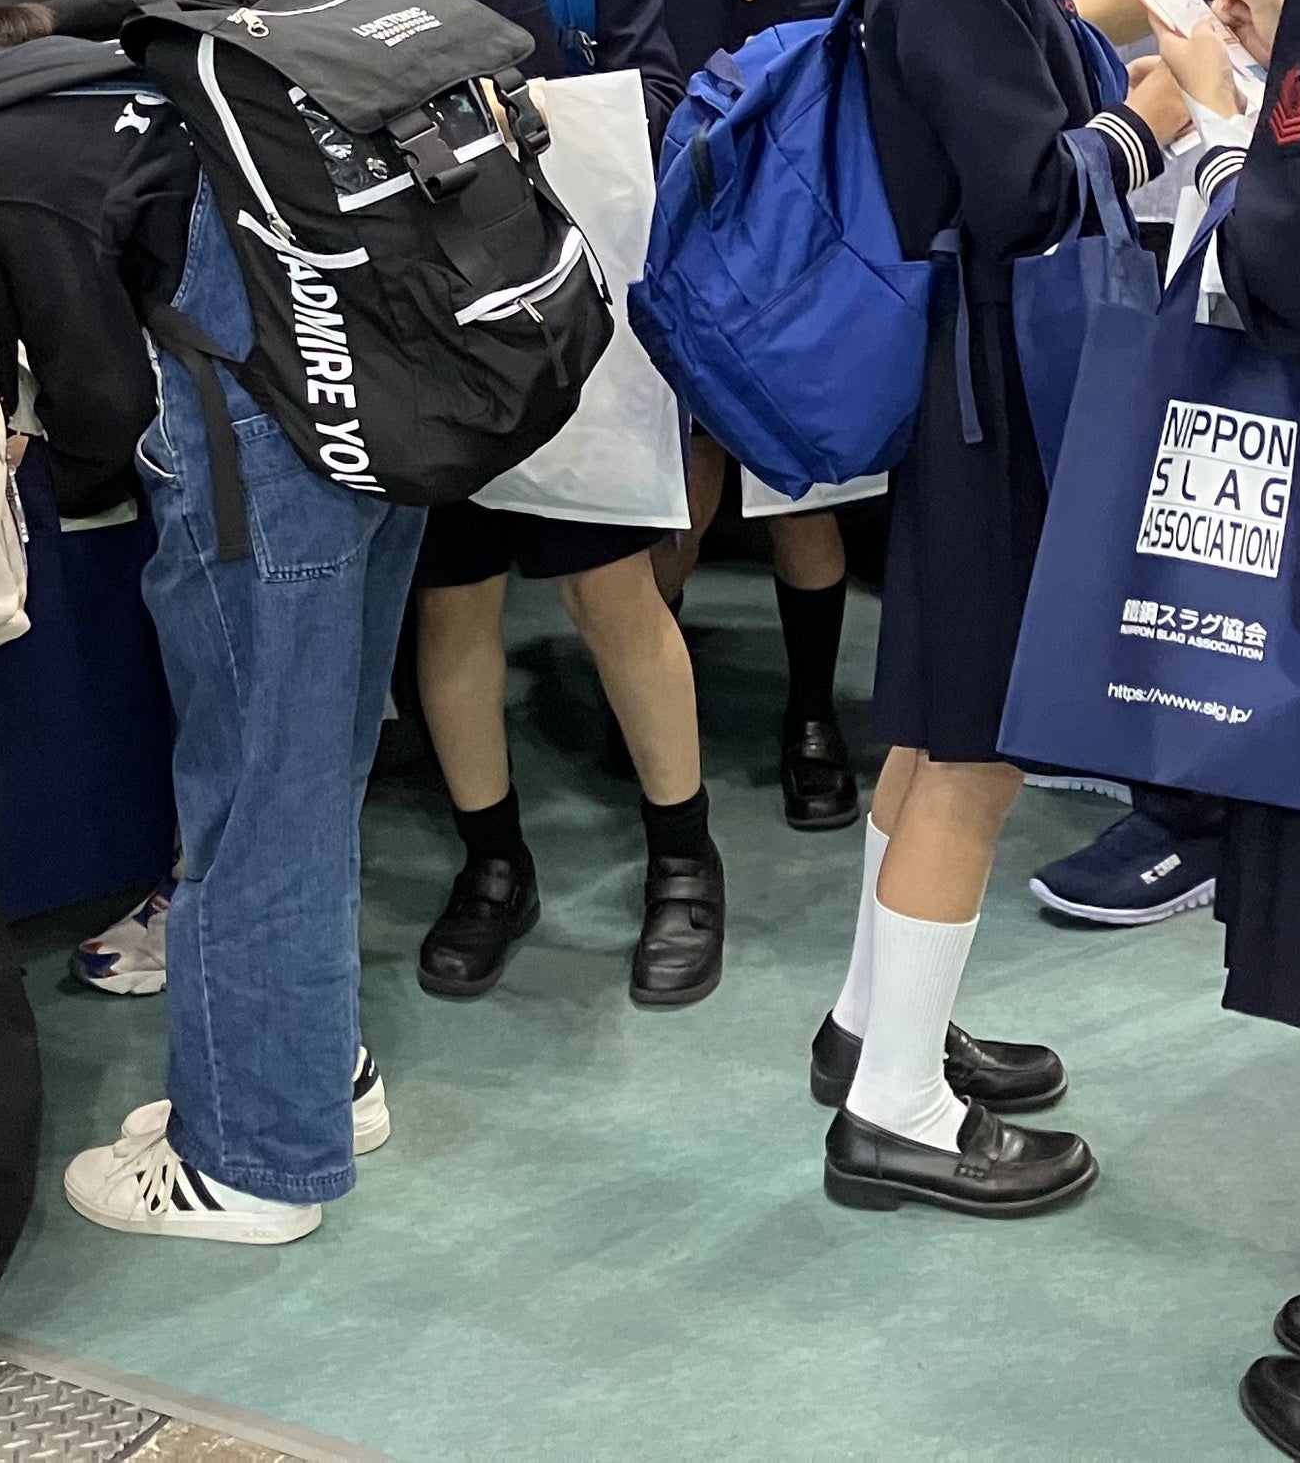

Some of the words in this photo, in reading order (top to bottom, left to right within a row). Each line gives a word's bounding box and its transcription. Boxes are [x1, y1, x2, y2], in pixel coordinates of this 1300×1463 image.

[277, 252, 358, 409] ADMIRE
[1164, 406, 1297, 467] NIPPON
[1151, 457, 1288, 519] SLAG
[1139, 507, 1281, 570] ASSOCIATION
